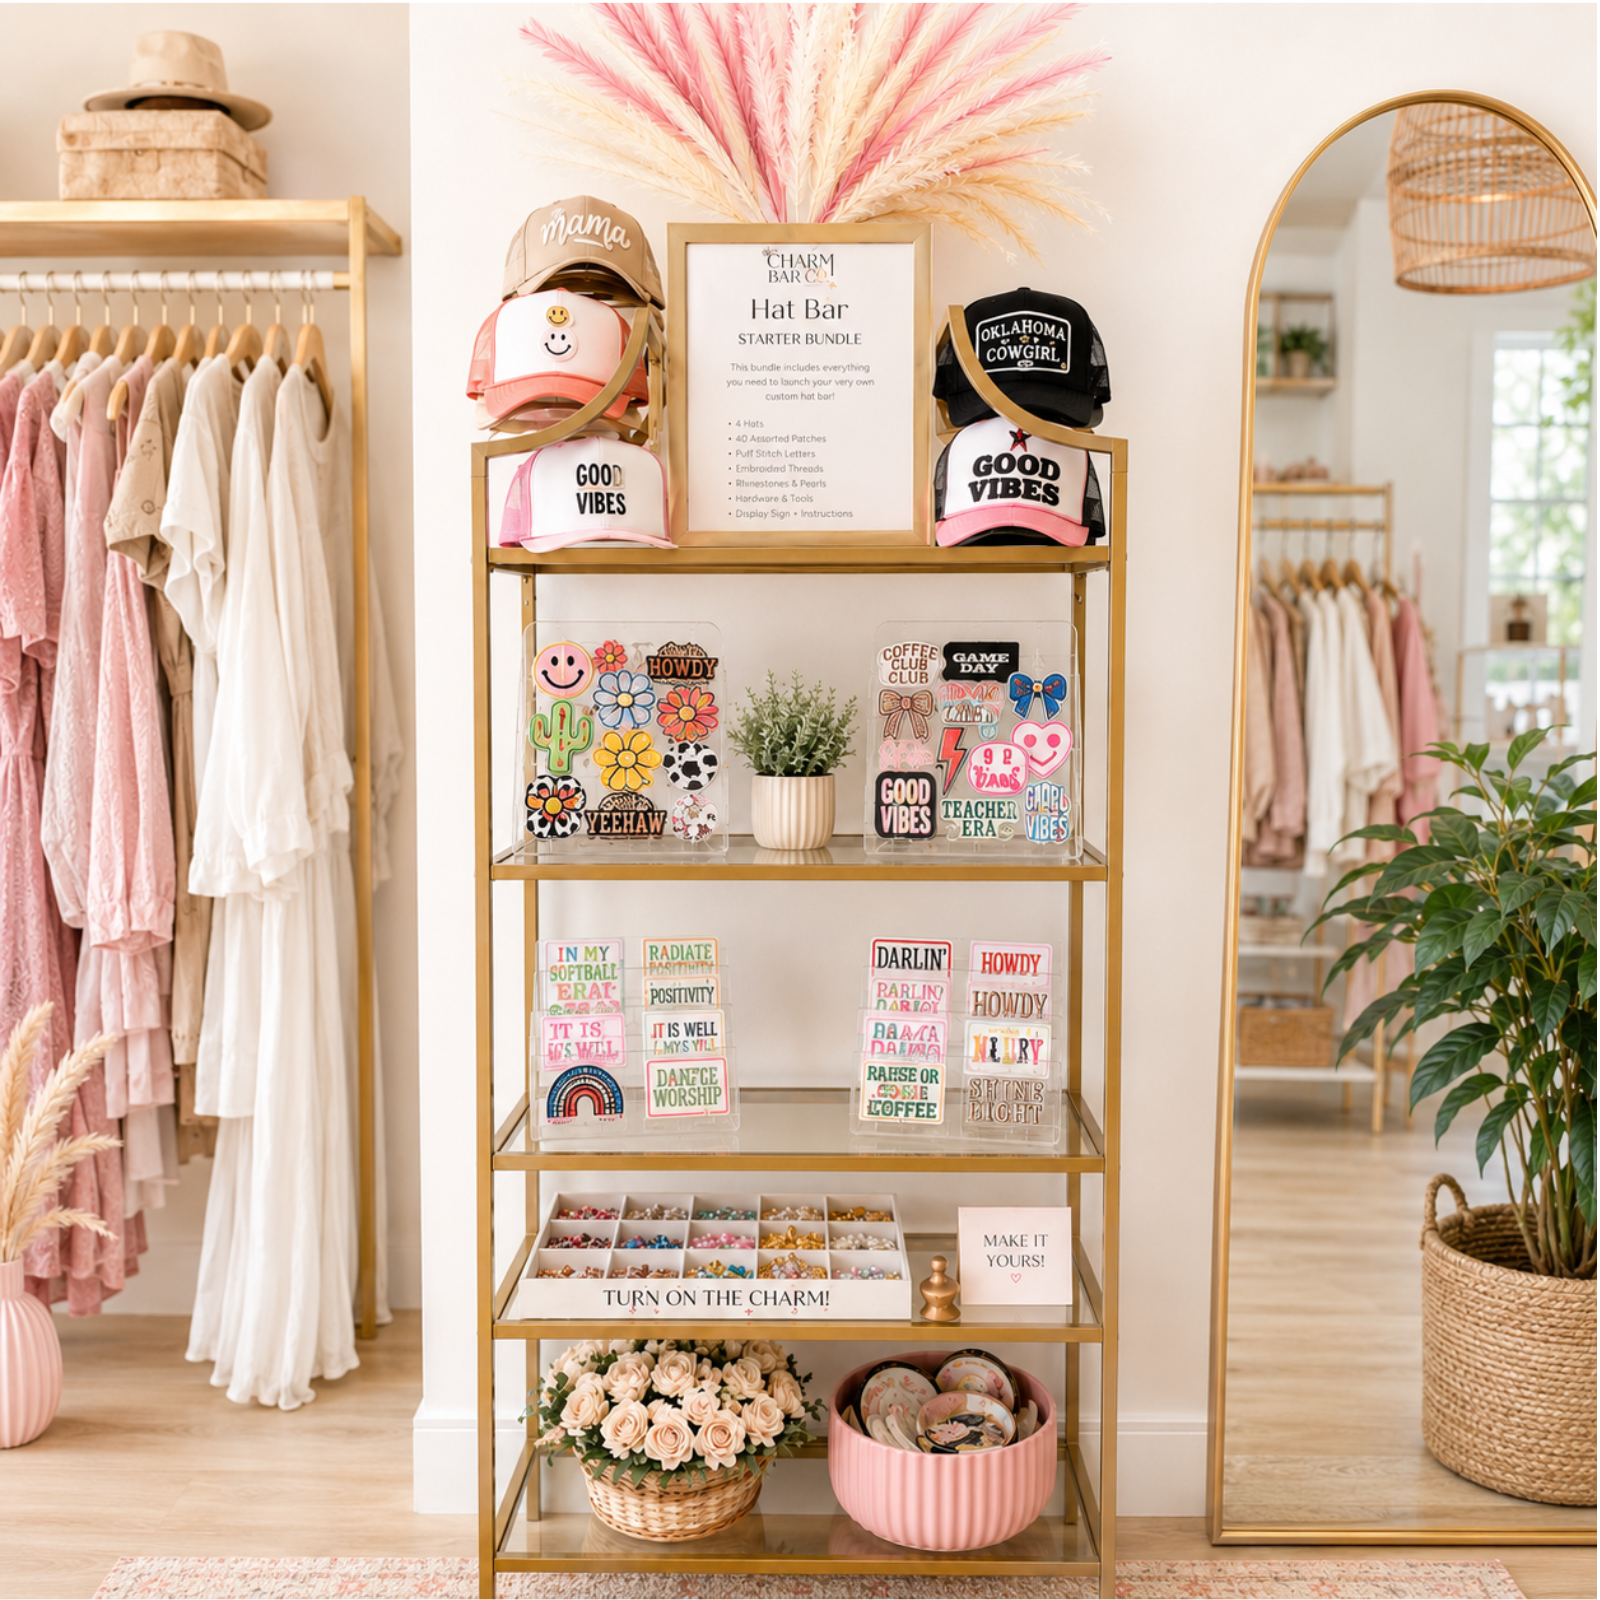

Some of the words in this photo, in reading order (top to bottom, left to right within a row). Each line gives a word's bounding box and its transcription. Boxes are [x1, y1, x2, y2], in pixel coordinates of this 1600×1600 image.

[541, 208, 631, 251] mama
[767, 253, 834, 277] CHARM
[768, 269, 802, 284] BAR
[751, 298, 796, 320] Hat
[804, 298, 849, 320] Bar
[738, 333, 801, 345] STARTER
[804, 333, 862, 345] BUNDLE
[981, 319, 1067, 343] OKLAHOMA
[986, 344, 1061, 364] COWGIRL
[730, 362, 749, 372] This
[750, 362, 781, 372] bundle
[783, 362, 821, 372] includes
[822, 362, 871, 374] everything
[726, 379, 743, 388] you
[745, 377, 768, 387] need
[769, 378, 779, 387] to
[780, 377, 811, 387] launch
[812, 379, 832, 388] your
[834, 379, 854, 388] very
[856, 379, 875, 387] own
[765, 392, 799, 401] custom
[800, 391, 815, 401] hat
[817, 391, 835, 401] bar!
[735, 419, 742, 428] 4
[743, 419, 765, 428] Hats
[735, 434, 748, 443] 40
[749, 434, 790, 443] Assorted
[791, 434, 827, 443] Patches
[735, 448, 754, 458] Puff
[755, 448, 783, 458] Stitch
[784, 448, 816, 458] Letters
[576, 463, 625, 487] GOOD
[788, 463, 824, 473] Threads
[972, 452, 1061, 481] GOOD
[791, 479, 798, 488] &
[800, 479, 827, 488] Pearls
[968, 477, 1060, 506] VIBES
[576, 491, 627, 516] VIBES
[735, 493, 780, 503] Hardware
[781, 494, 788, 503] &
[790, 493, 814, 503] Tools
[735, 508, 769, 519] Display
[771, 508, 791, 520] Sign
[800, 508, 854, 518] Instructions
[883, 642, 939, 662] COFFEE
[952, 652, 1010, 663] GAME
[650, 658, 717, 677] HOWDY
[891, 658, 929, 672] CLUB
[959, 663, 999, 674] DAY
[880, 777, 932, 805] GOOD
[586, 811, 666, 834] YEEHAW
[880, 805, 932, 836] VIBES
[961, 819, 998, 838] ERA
[557, 947, 578, 963] IN
[584, 945, 610, 962] MY
[648, 943, 713, 962] RADIATE
[877, 945, 947, 971] DARLIN'
[549, 962, 618, 982] SOFTBALL
[981, 951, 1042, 976] HOWDY
[650, 986, 715, 1006] POSITIVITY
[972, 990, 1048, 1020] HOWDY
[549, 1021, 573, 1041] IT
[579, 1021, 602, 1039] IS
[651, 1022, 665, 1039] IT
[667, 1022, 680, 1038] IS
[683, 1021, 718, 1038] WELL
[920, 1068, 939, 1085] OR
[653, 1086, 722, 1108] WORSHIP
[983, 1234, 1029, 1248] MAKE
[1034, 1234, 1049, 1248] IT
[986, 1254, 1045, 1268] YOURS!
[603, 1289, 660, 1306] TURN
[665, 1289, 697, 1306] ON
[703, 1289, 743, 1306] THE
[749, 1289, 830, 1306] CHARM!
